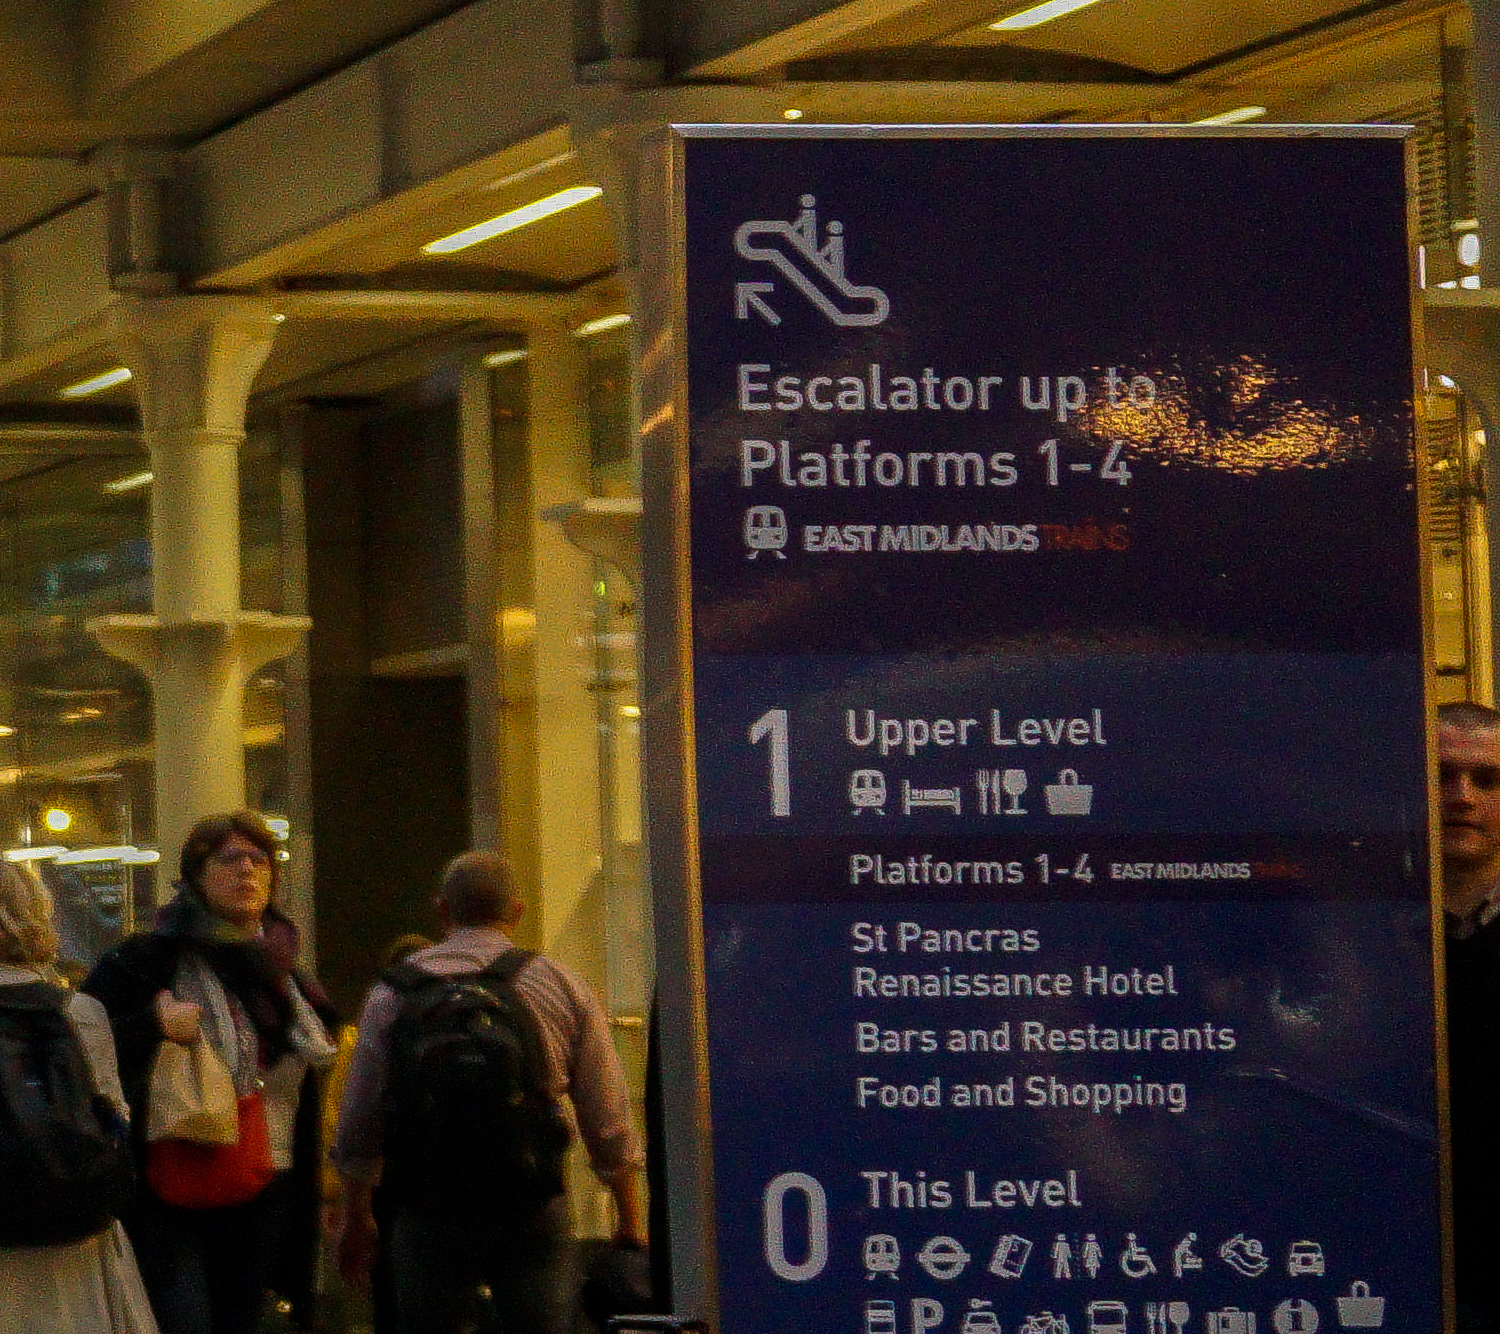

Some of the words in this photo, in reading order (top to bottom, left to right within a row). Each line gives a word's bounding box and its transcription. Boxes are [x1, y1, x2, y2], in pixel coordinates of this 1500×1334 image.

[737, 364, 1002, 411] Escalator
[1022, 374, 1087, 422] up
[1105, 367, 1156, 409] to
[740, 438, 1018, 487] Platforms
[1037, 438, 1134, 487] 1-4
[804, 525, 876, 552] EAST
[880, 524, 1039, 552] MIDLANDS
[847, 710, 977, 755] Upper
[992, 709, 1106, 746] Level
[750, 710, 790, 816] 1
[851, 854, 1024, 884] Platforms
[1035, 853, 1094, 883] 1-4
[853, 922, 887, 952] St
[898, 922, 1040, 952] Pancras
[855, 966, 1072, 997] Renaissance
[1084, 966, 1177, 995] Hotel
[858, 1022, 938, 1052] Bars
[949, 1022, 1010, 1051] and
[1021, 1021, 1236, 1051] Restaurants
[858, 1077, 941, 1107] Food
[953, 1077, 1014, 1107] and
[1025, 1076, 1186, 1114] Shopping
[862, 1171, 952, 1208] This
[968, 1170, 1082, 1207] Level
[765, 1172, 828, 1281] 0
